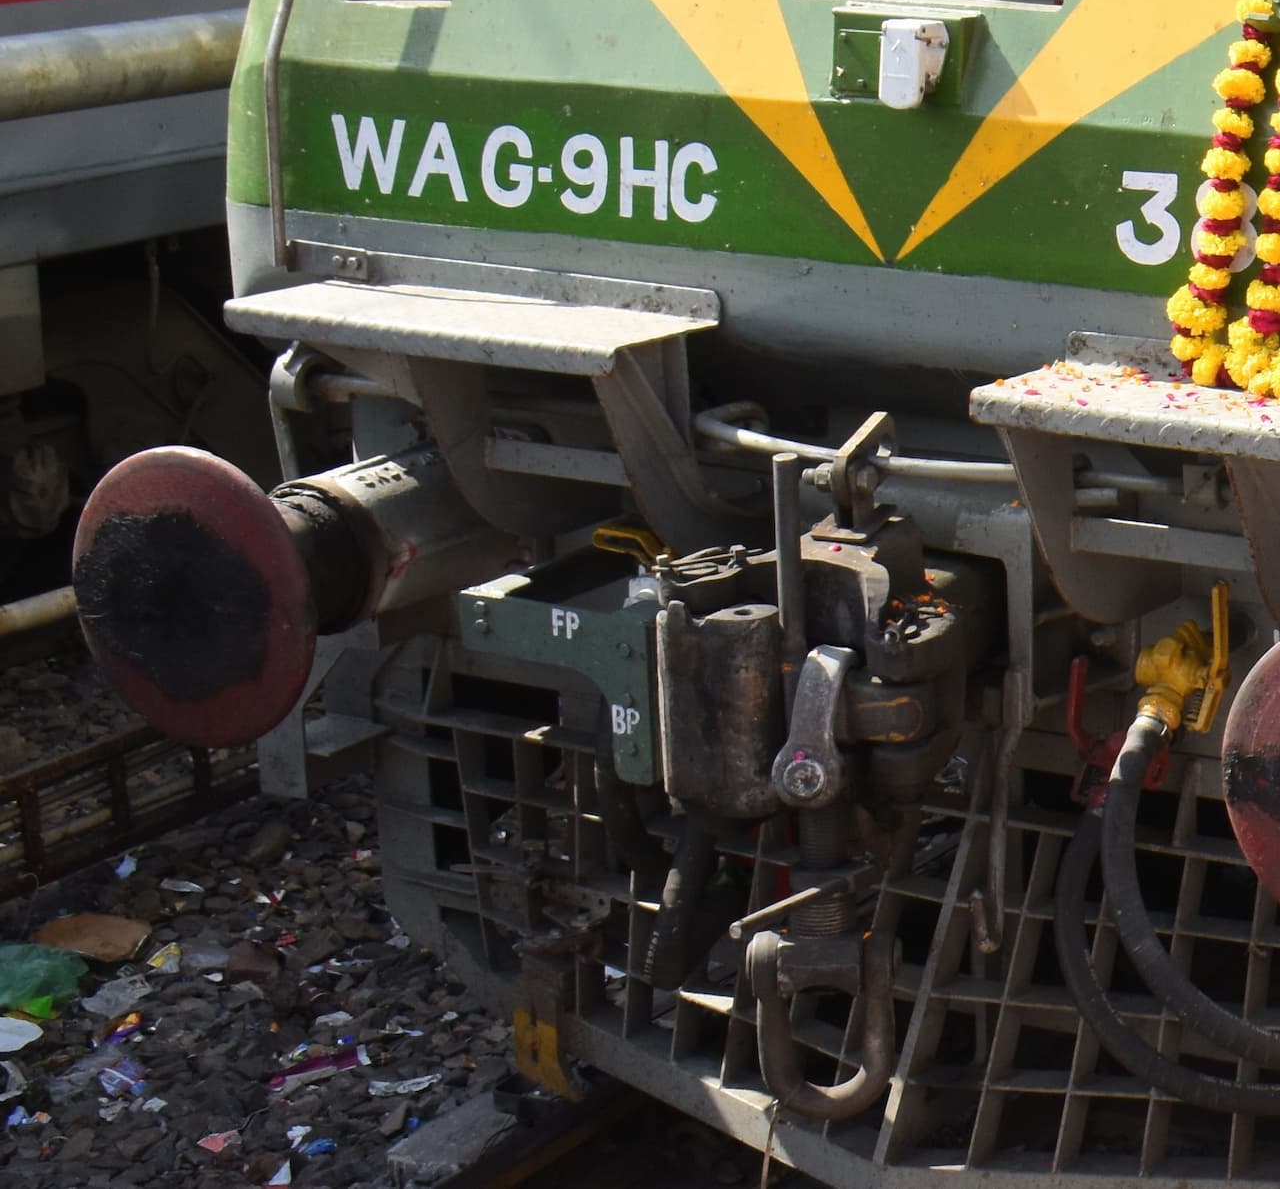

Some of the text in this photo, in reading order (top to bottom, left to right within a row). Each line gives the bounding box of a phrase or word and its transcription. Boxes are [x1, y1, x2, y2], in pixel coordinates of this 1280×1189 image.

[331, 114, 719, 223] WAG-9HC
[551, 608, 580, 640] FP
[611, 704, 640, 735] BP
